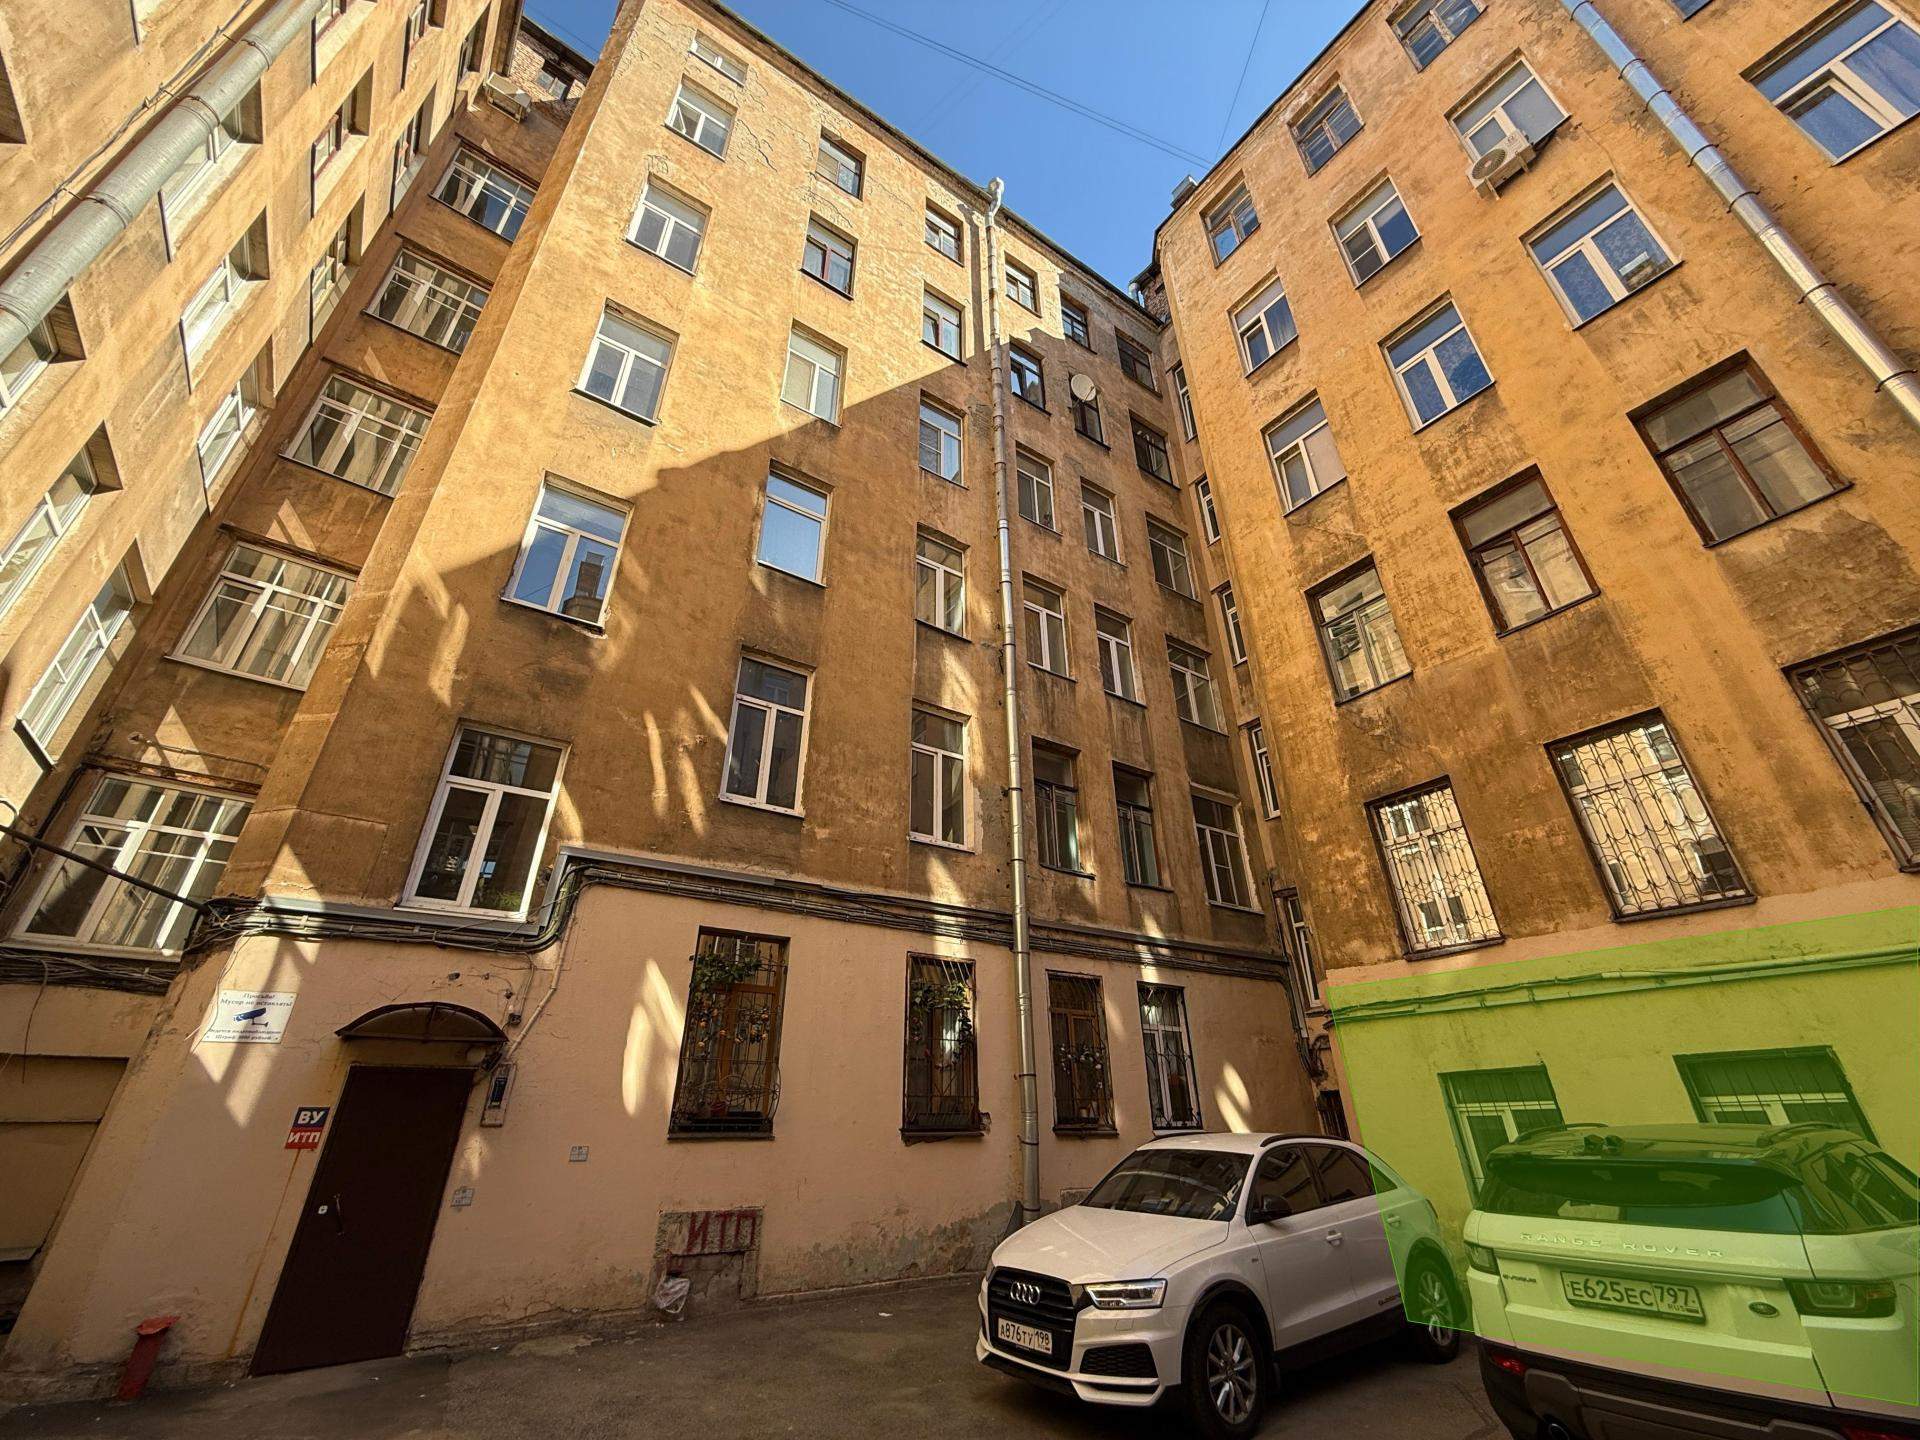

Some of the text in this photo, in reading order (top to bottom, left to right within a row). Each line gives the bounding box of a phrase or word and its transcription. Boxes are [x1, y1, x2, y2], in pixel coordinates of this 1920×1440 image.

[297, 1110, 326, 1125] ВУ
[287, 1131, 321, 1143] ИТП
[1519, 1232, 1724, 1258] RANGE ROVER
